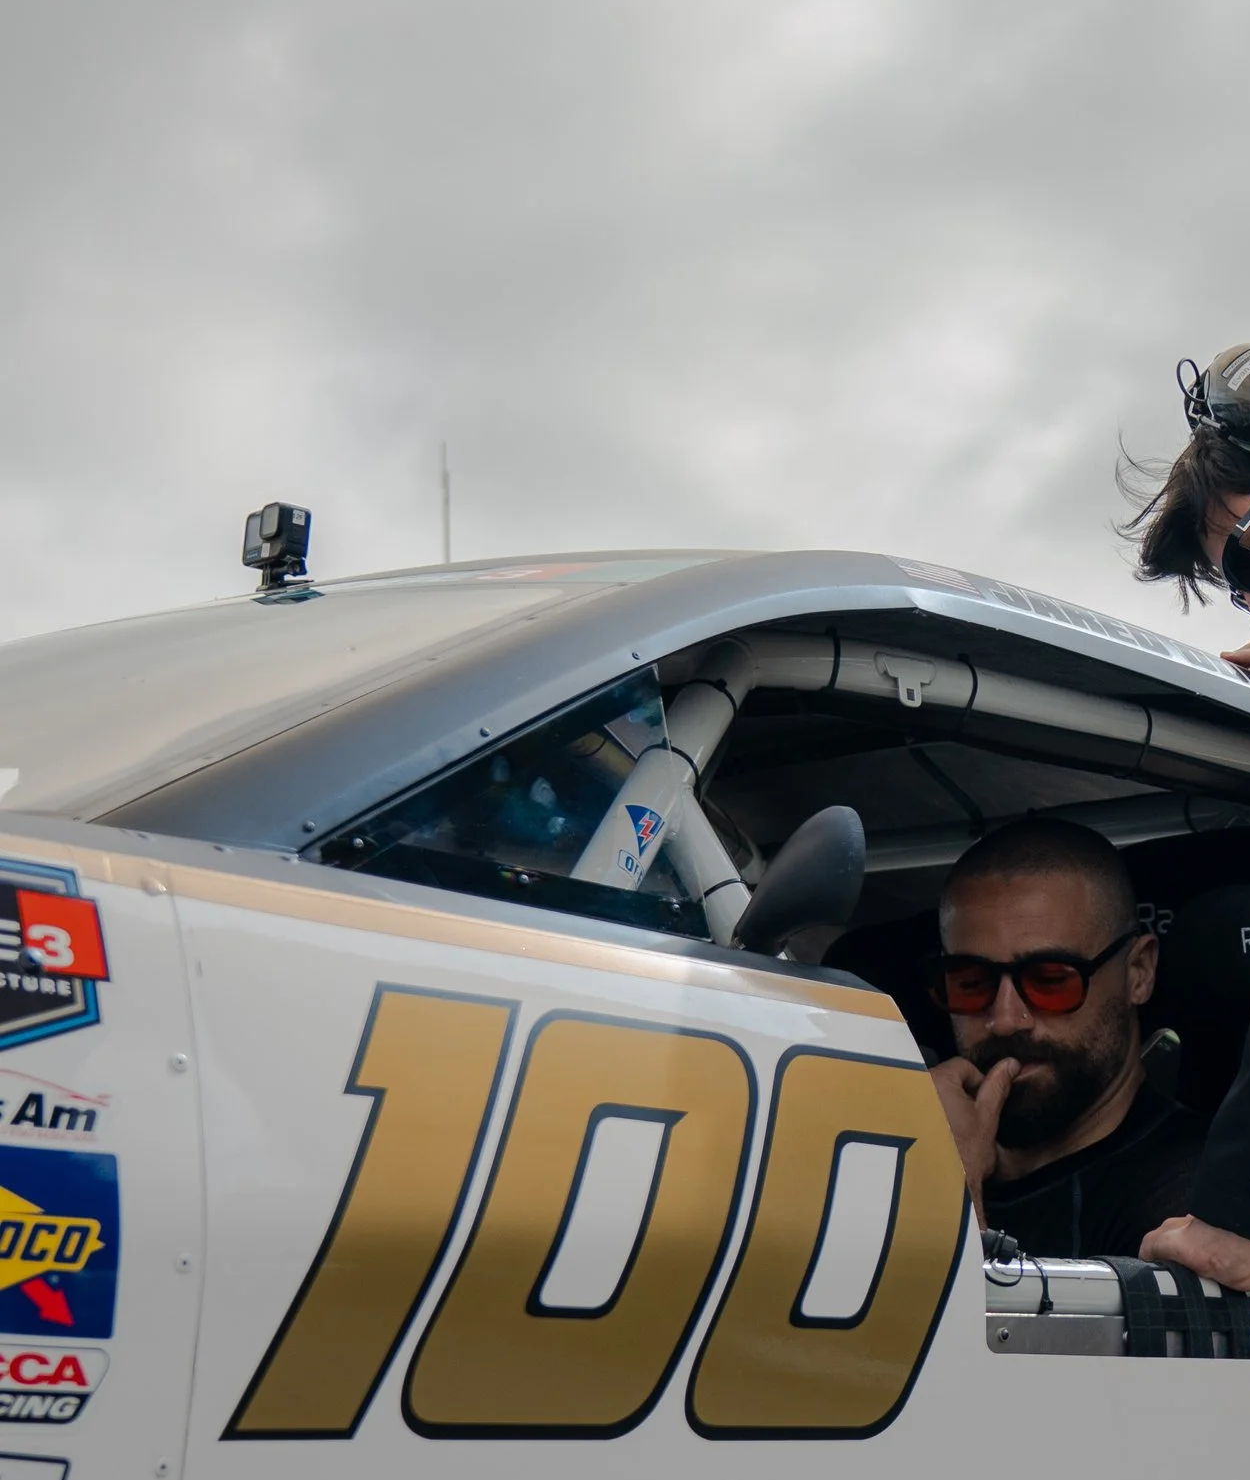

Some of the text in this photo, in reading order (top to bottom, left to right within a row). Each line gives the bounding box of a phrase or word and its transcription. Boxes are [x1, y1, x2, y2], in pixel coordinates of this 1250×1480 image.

[10, 1092, 97, 1131] Am
[218, 981, 972, 1441] 100
[0, 1351, 89, 1387] CA
